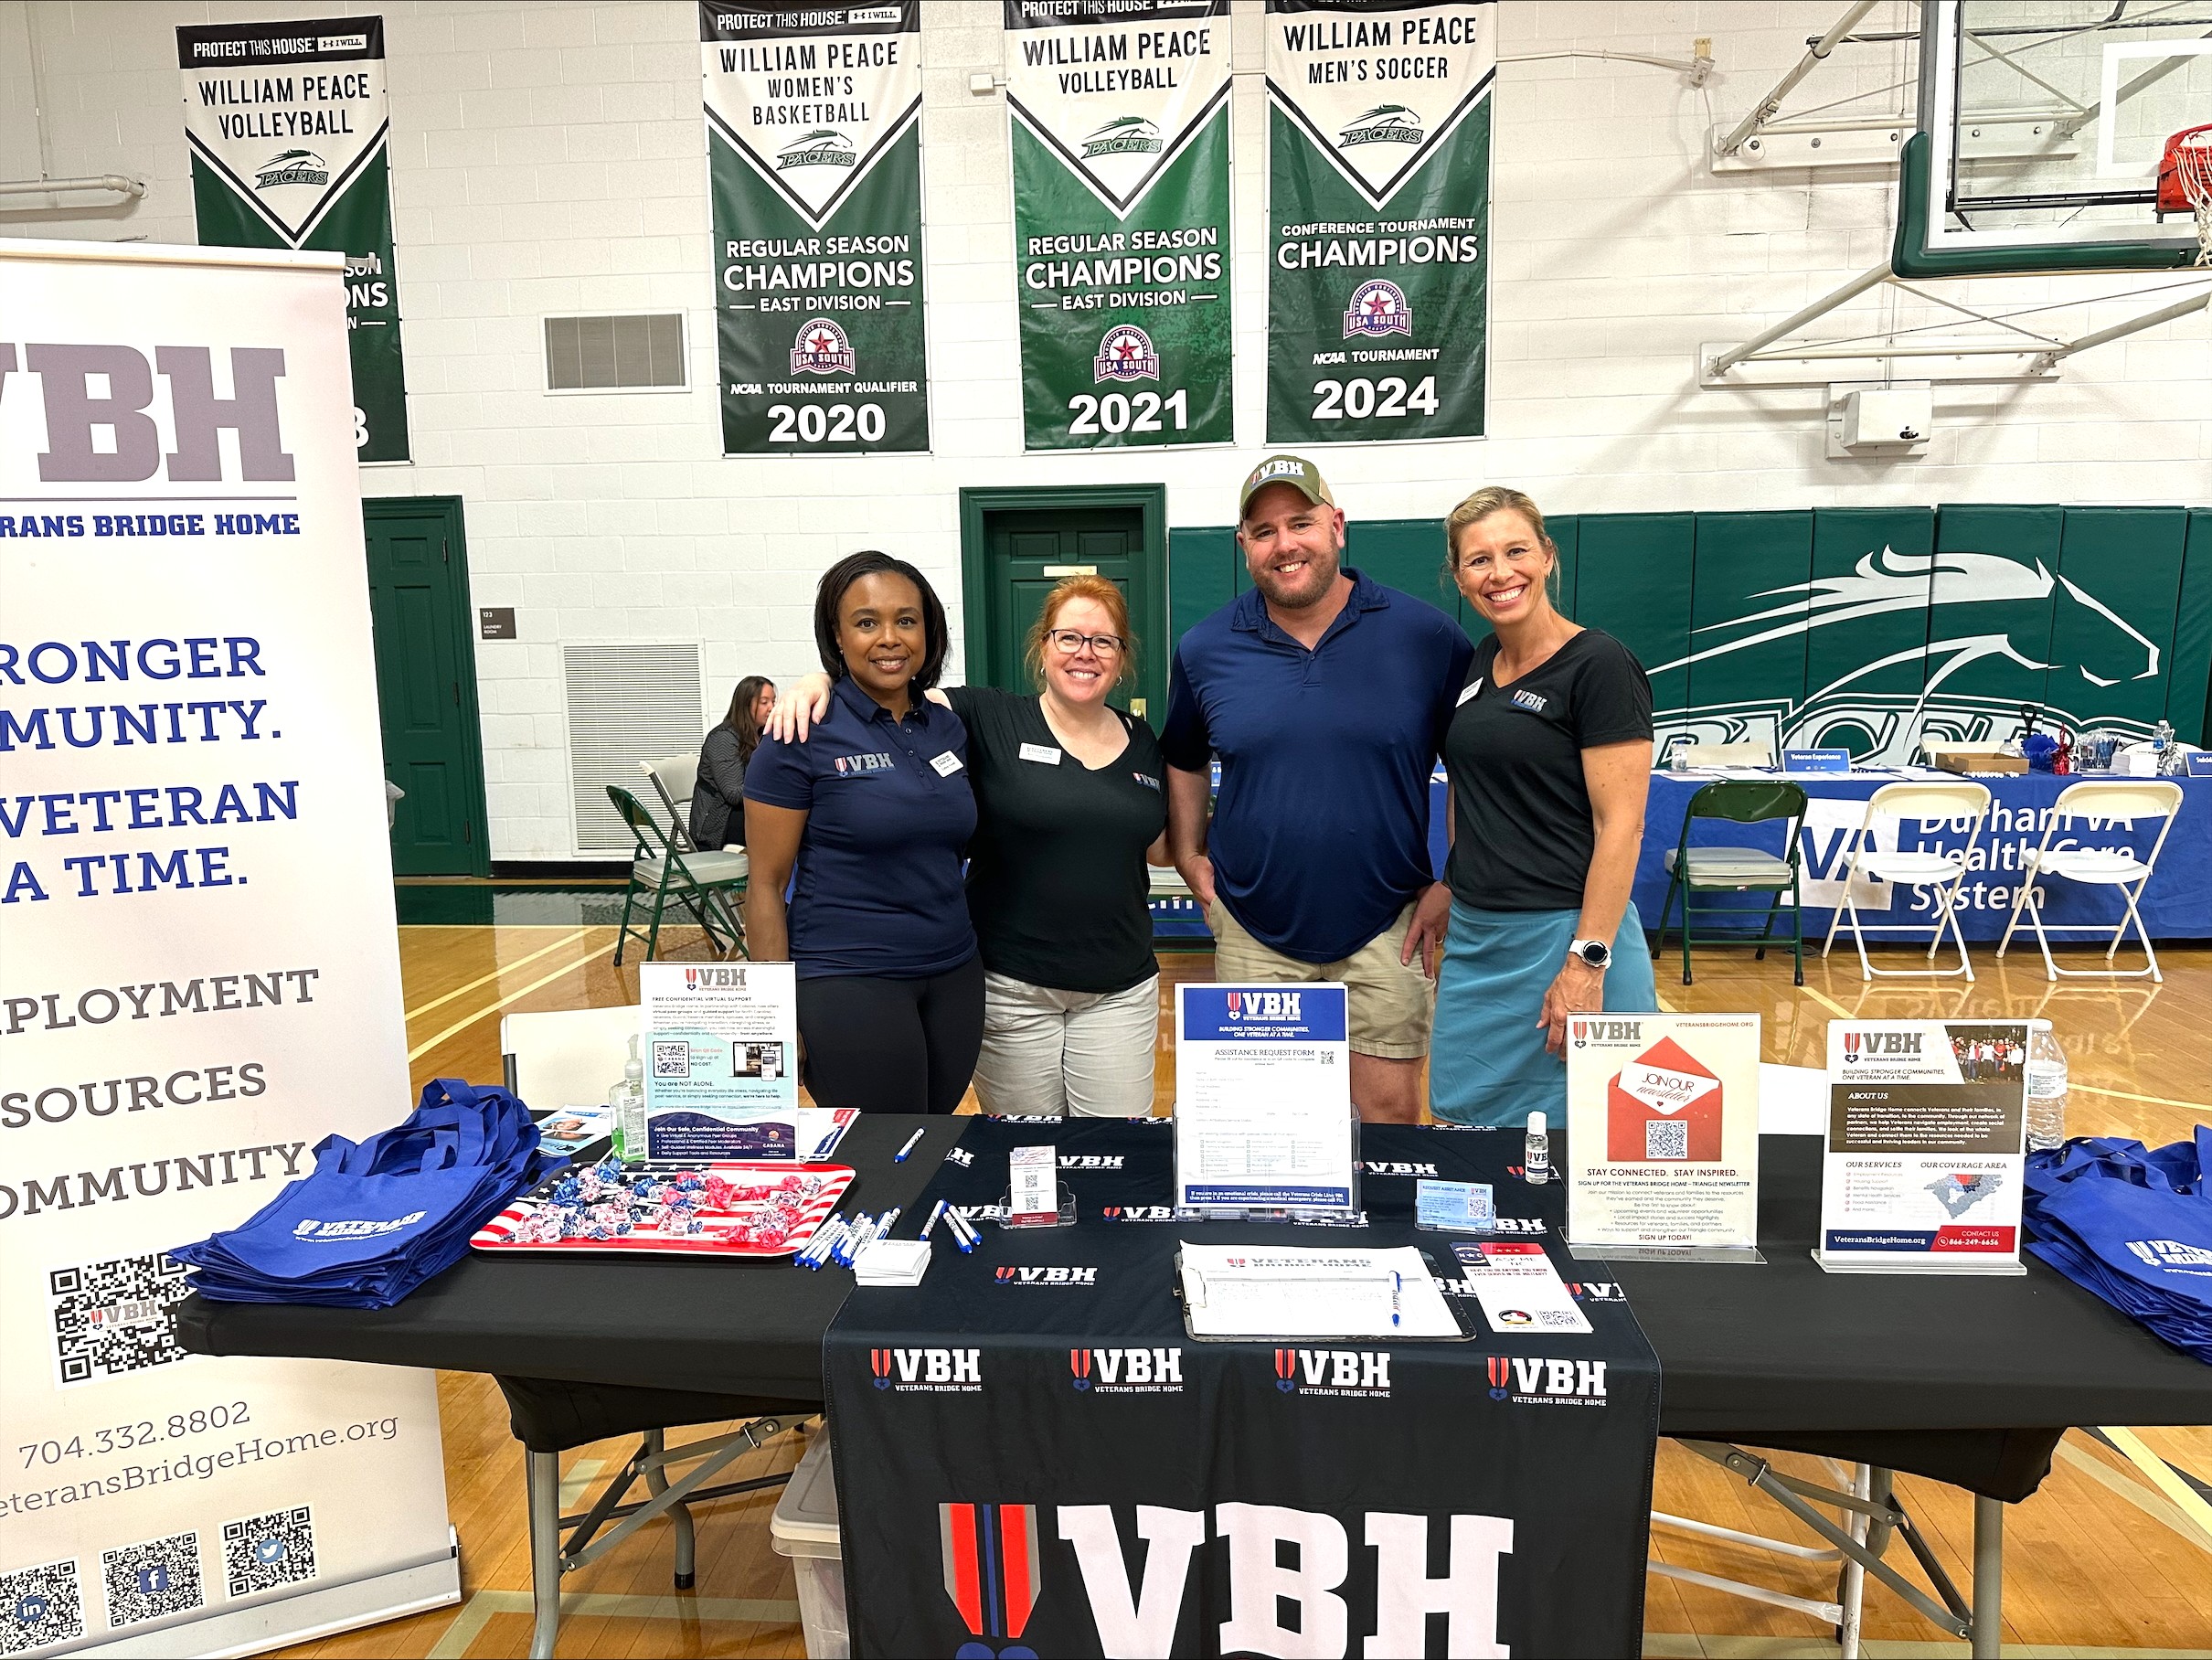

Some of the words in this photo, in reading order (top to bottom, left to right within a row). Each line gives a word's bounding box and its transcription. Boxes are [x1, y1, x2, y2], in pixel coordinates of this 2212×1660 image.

[1021, 1, 1078, 17] PROTECT
[1082, 0, 1104, 15] THIS
[717, 14, 773, 30] PROTECT
[776, 14, 798, 27] THIS
[1283, 22, 1390, 51] WILLIAM
[1403, 17, 1476, 45] PEACE
[194, 41, 247, 58] PROTECT
[250, 40, 271, 56] THIS
[720, 45, 815, 72] WILLIAM
[828, 41, 898, 69] PEACE
[1023, 34, 1127, 66] WILLIAM
[1138, 29, 1210, 59] PEACE
[1059, 68, 1177, 94] VOLLEYBALL
[1309, 59, 1367, 84] MEN'S
[1377, 58, 1448, 80] SOCCER
[198, 78, 293, 106] WILLIAM
[303, 74, 369, 101] PEACE
[768, 76, 853, 98] WOMEN'S
[753, 102, 869, 124] BASKETBALL
[219, 110, 353, 139] VOLLEYBALL
[1086, 139, 1163, 155] PACERS
[1345, 127, 1424, 145] PACERS
[781, 151, 856, 169] PACERS
[260, 170, 328, 186] PACERS
[1281, 223, 1374, 236] CONFERENCE
[1378, 218, 1475, 232] TOURNAMENT
[727, 239, 821, 258] REGULAR
[826, 236, 909, 254] SEASON
[1028, 234, 1124, 255] REGULAR
[1131, 228, 1217, 250] SEASON
[1278, 235, 1477, 269] CHAMPIONS
[724, 261, 914, 290] CHAMPIONS
[1026, 253, 1221, 289] CHAMPIONS
[760, 298, 801, 312] EAST
[806, 296, 881, 311] DIVISION
[1062, 294, 1104, 310] EAST
[1110, 290, 1186, 308] DIVISION
[1349, 316, 1368, 330] USA
[1374, 314, 1406, 327] SOUTH
[795, 353, 814, 367] USA
[818, 353, 850, 363] SOUTH
[1100, 360, 1118, 373] USA
[1123, 359, 1154, 371] SOUTH
[1313, 352, 1345, 365] NCAA
[1352, 348, 1440, 362] TOURNAMENT
[730, 384, 763, 394] NCAA
[768, 383, 851, 393] TOURNAMENT
[855, 382, 918, 392] QUALIFIER
[1312, 377, 1439, 419] 2024
[0, 343, 295, 482] BH
[1069, 388, 1187, 434] 2021
[768, 404, 886, 442] 2020
[1259, 460, 1304, 482] VBH
[95, 515, 205, 537] BRIDGE
[216, 514, 300, 535] HOME
[0, 637, 265, 685] RONGER
[1518, 691, 1547, 712] VBH
[847, 752, 894, 771] VBH
[1812, 753, 1841, 761] Experience
[0, 782, 299, 838] VETERAN
[2, 862, 48, 904] A
[64, 847, 247, 898] TIME.
[1910, 881, 2046, 919] System
[698, 969, 746, 985] VBH
[4, 969, 318, 1035] PLOYMENT
[1243, 993, 1301, 1015] VBH
[1590, 1021, 1641, 1040] VBH
[1864, 1033, 1921, 1053] VBH
[1642, 1073, 1668, 1087] JOIN
[1668, 1078, 1694, 1091] OUR
[1, 1064, 266, 1128] SOURCES
[1636, 1086, 1692, 1102] newsletter
[1058, 1155, 1124, 1166] VBH
[1366, 1162, 1438, 1174] VBH
[1834, 1236, 1926, 1244] VeteransBridgeHome.org
[1950, 1238, 1998, 1246] 866-249-6656
[1018, 1267, 1098, 1281] VBH
[104, 1300, 156, 1323] VBH
[893, 1348, 981, 1383] VBH
[1093, 1348, 1183, 1383] VBH
[1299, 1349, 1390, 1388] VBH
[1513, 1357, 1607, 1396] VBH
[1095, 1386, 1133, 1394] VETERANS
[1163, 1385, 1183, 1393] HOME
[1299, 1388, 1339, 1397] VETERANS
[1341, 1389, 1367, 1398] BRIDGE
[1513, 1396, 1553, 1405] VETERANS
[1555, 1398, 1582, 1406] BRIDGE
[1584, 1399, 1606, 1407] HOME
[19, 1401, 250, 1469] 704.332.8802
[1058, 1500, 1514, 1660] VBH
